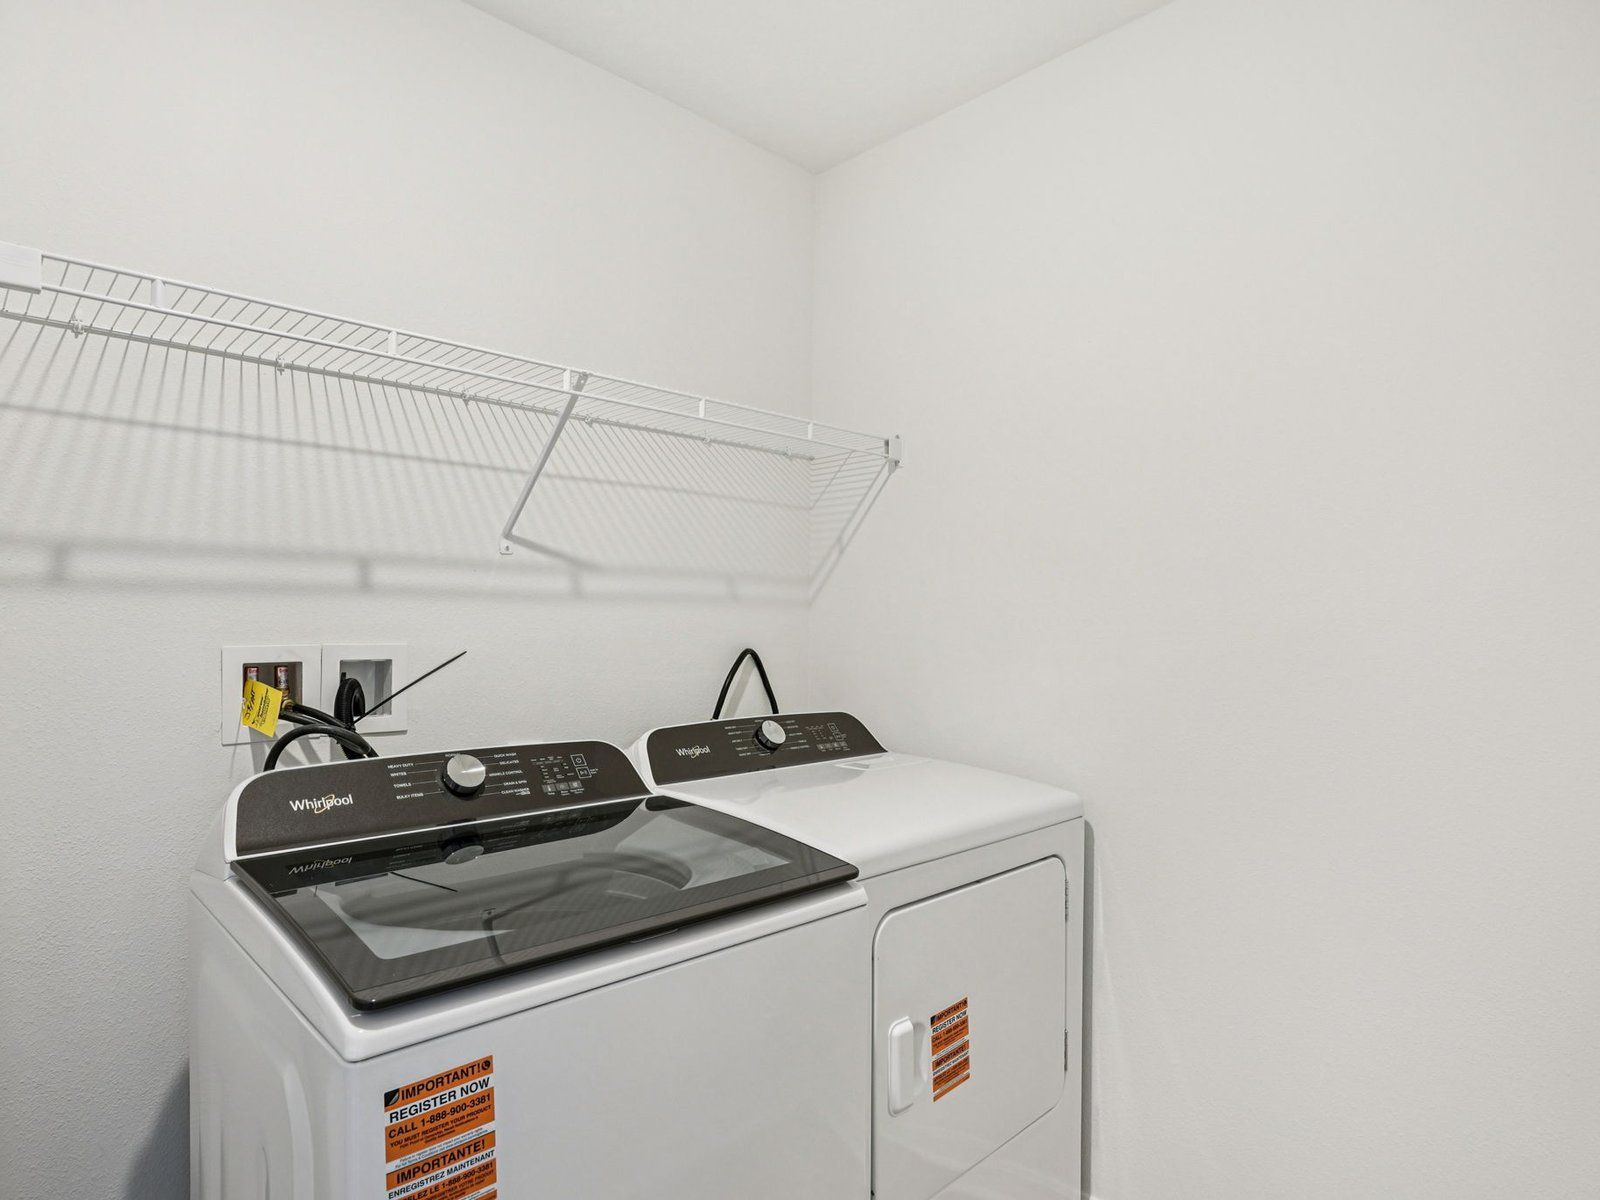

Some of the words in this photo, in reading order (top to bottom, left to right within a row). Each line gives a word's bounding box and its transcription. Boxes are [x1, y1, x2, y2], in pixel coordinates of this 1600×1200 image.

[676, 745, 711, 759] Whirlpool
[289, 793, 354, 813] Whirlpool
[389, 1089, 457, 1124] REGISTER
[460, 1077, 490, 1097] NOW
[401, 1063, 480, 1100] IMPORTANT!
[388, 1122, 418, 1139] CALL
[420, 1093, 491, 1127] 1-888-900-3381
[388, 1171, 445, 1200] ENREGISTREZ
[446, 1149, 495, 1176] MAINTENANT
[396, 1139, 486, 1184] IMPORTANTE!
